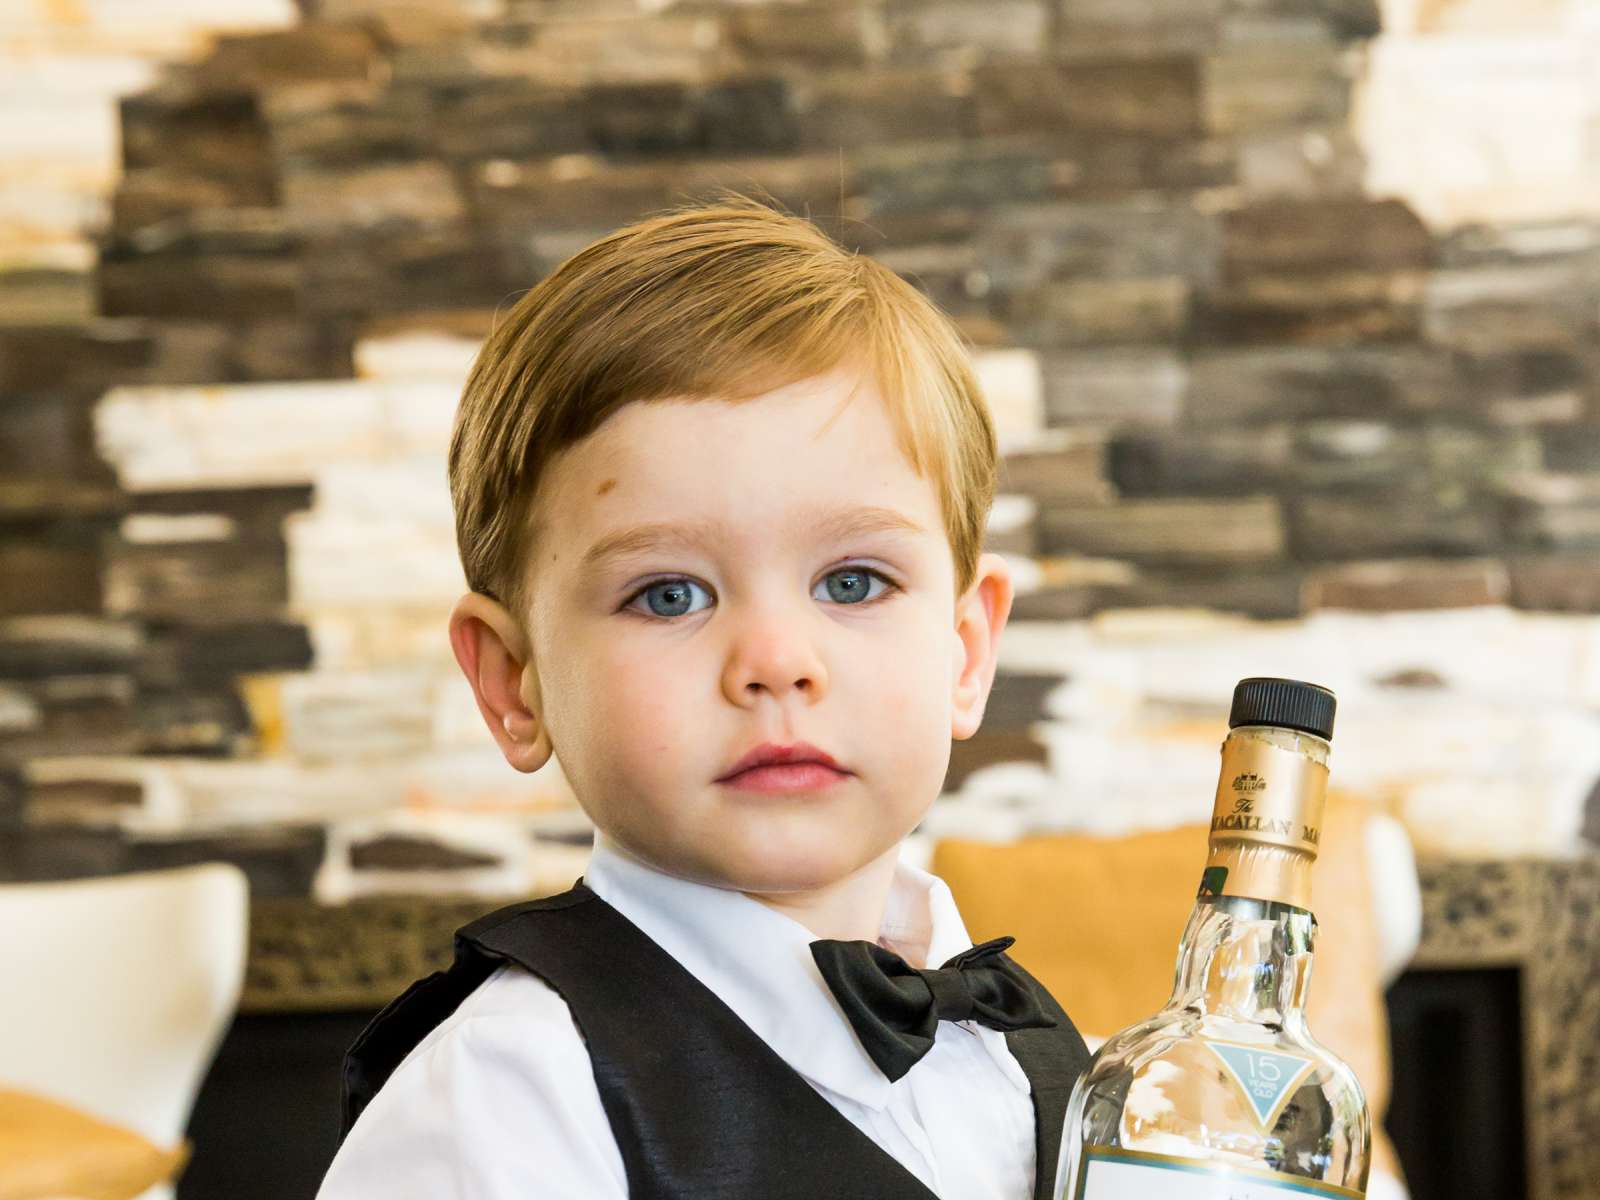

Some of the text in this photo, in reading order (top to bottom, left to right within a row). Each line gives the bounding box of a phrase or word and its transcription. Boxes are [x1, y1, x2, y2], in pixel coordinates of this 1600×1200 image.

[1232, 798, 1254, 814] The
[1246, 1053, 1281, 1081] 15
[1253, 1087, 1274, 1099] OLD
